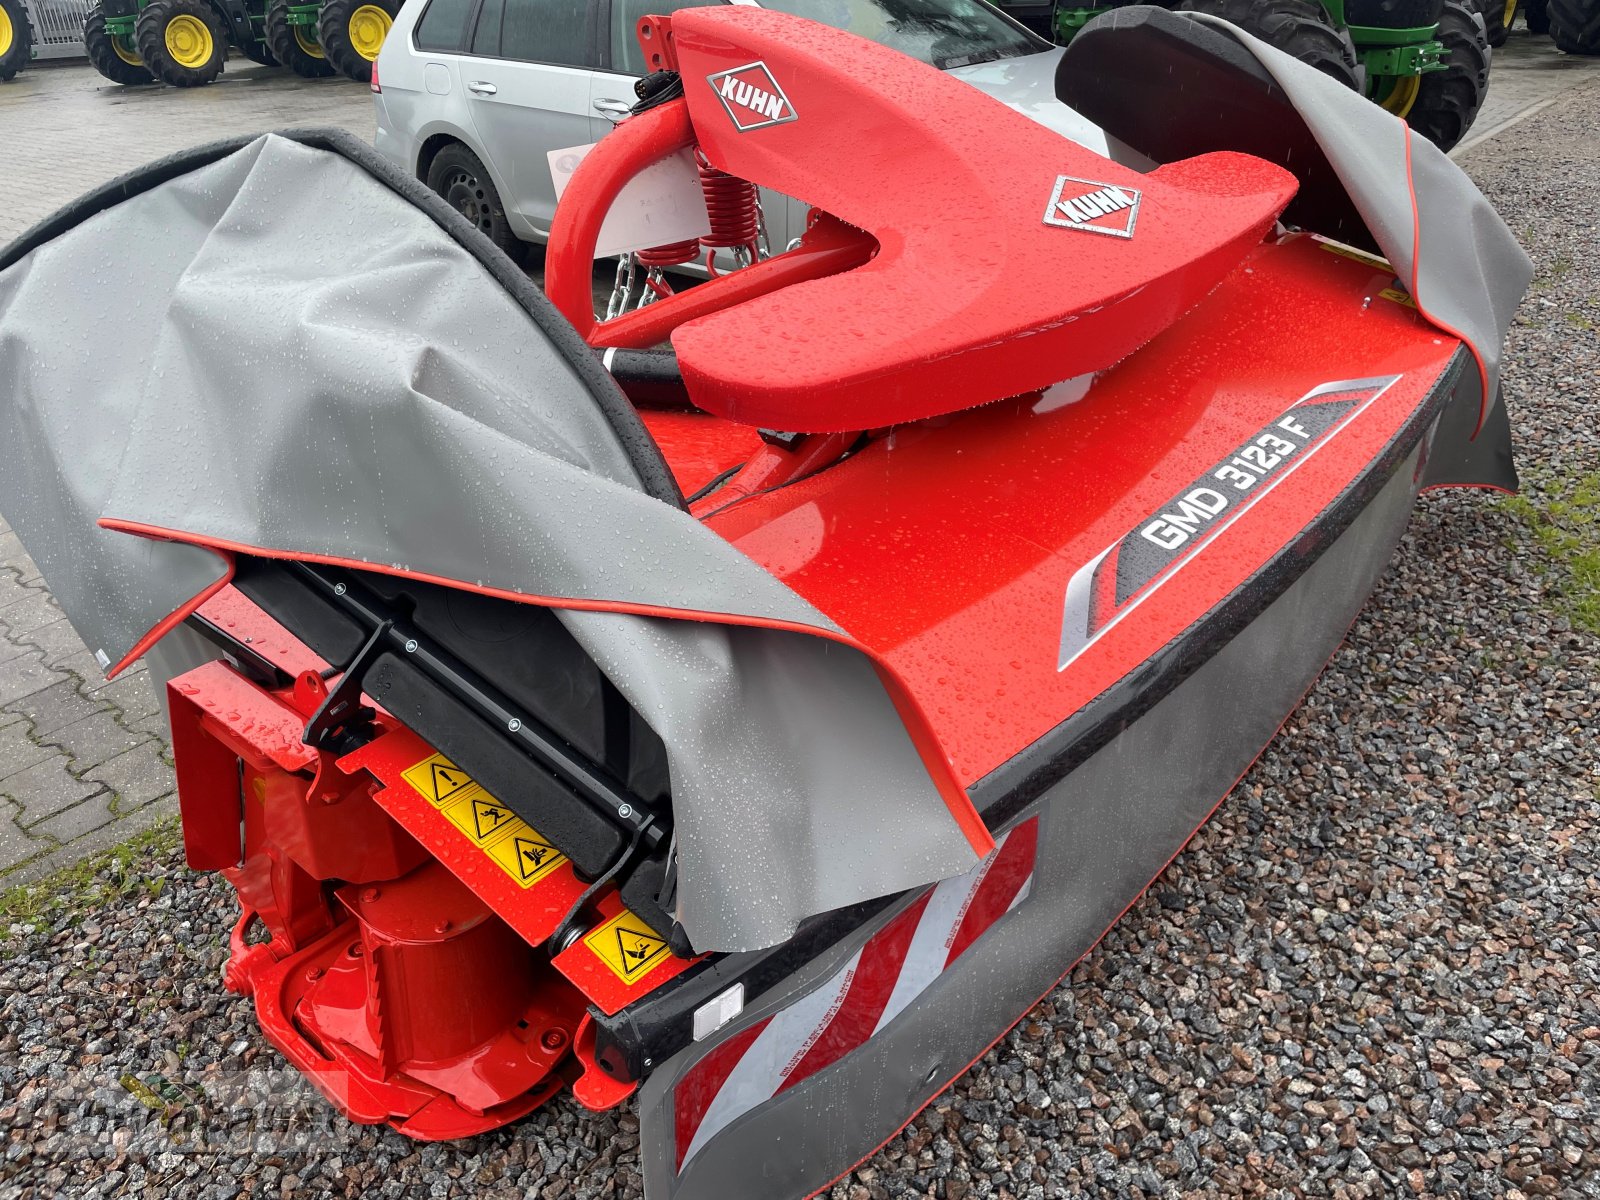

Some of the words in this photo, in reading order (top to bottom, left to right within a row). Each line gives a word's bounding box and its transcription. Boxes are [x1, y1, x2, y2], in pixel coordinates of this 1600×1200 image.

[720, 74, 785, 121] KUHN
[1055, 185, 1136, 224] KUHN
[1140, 487, 1228, 550] GMD
[1214, 433, 1297, 490] 3123
[1277, 415, 1311, 439] F
